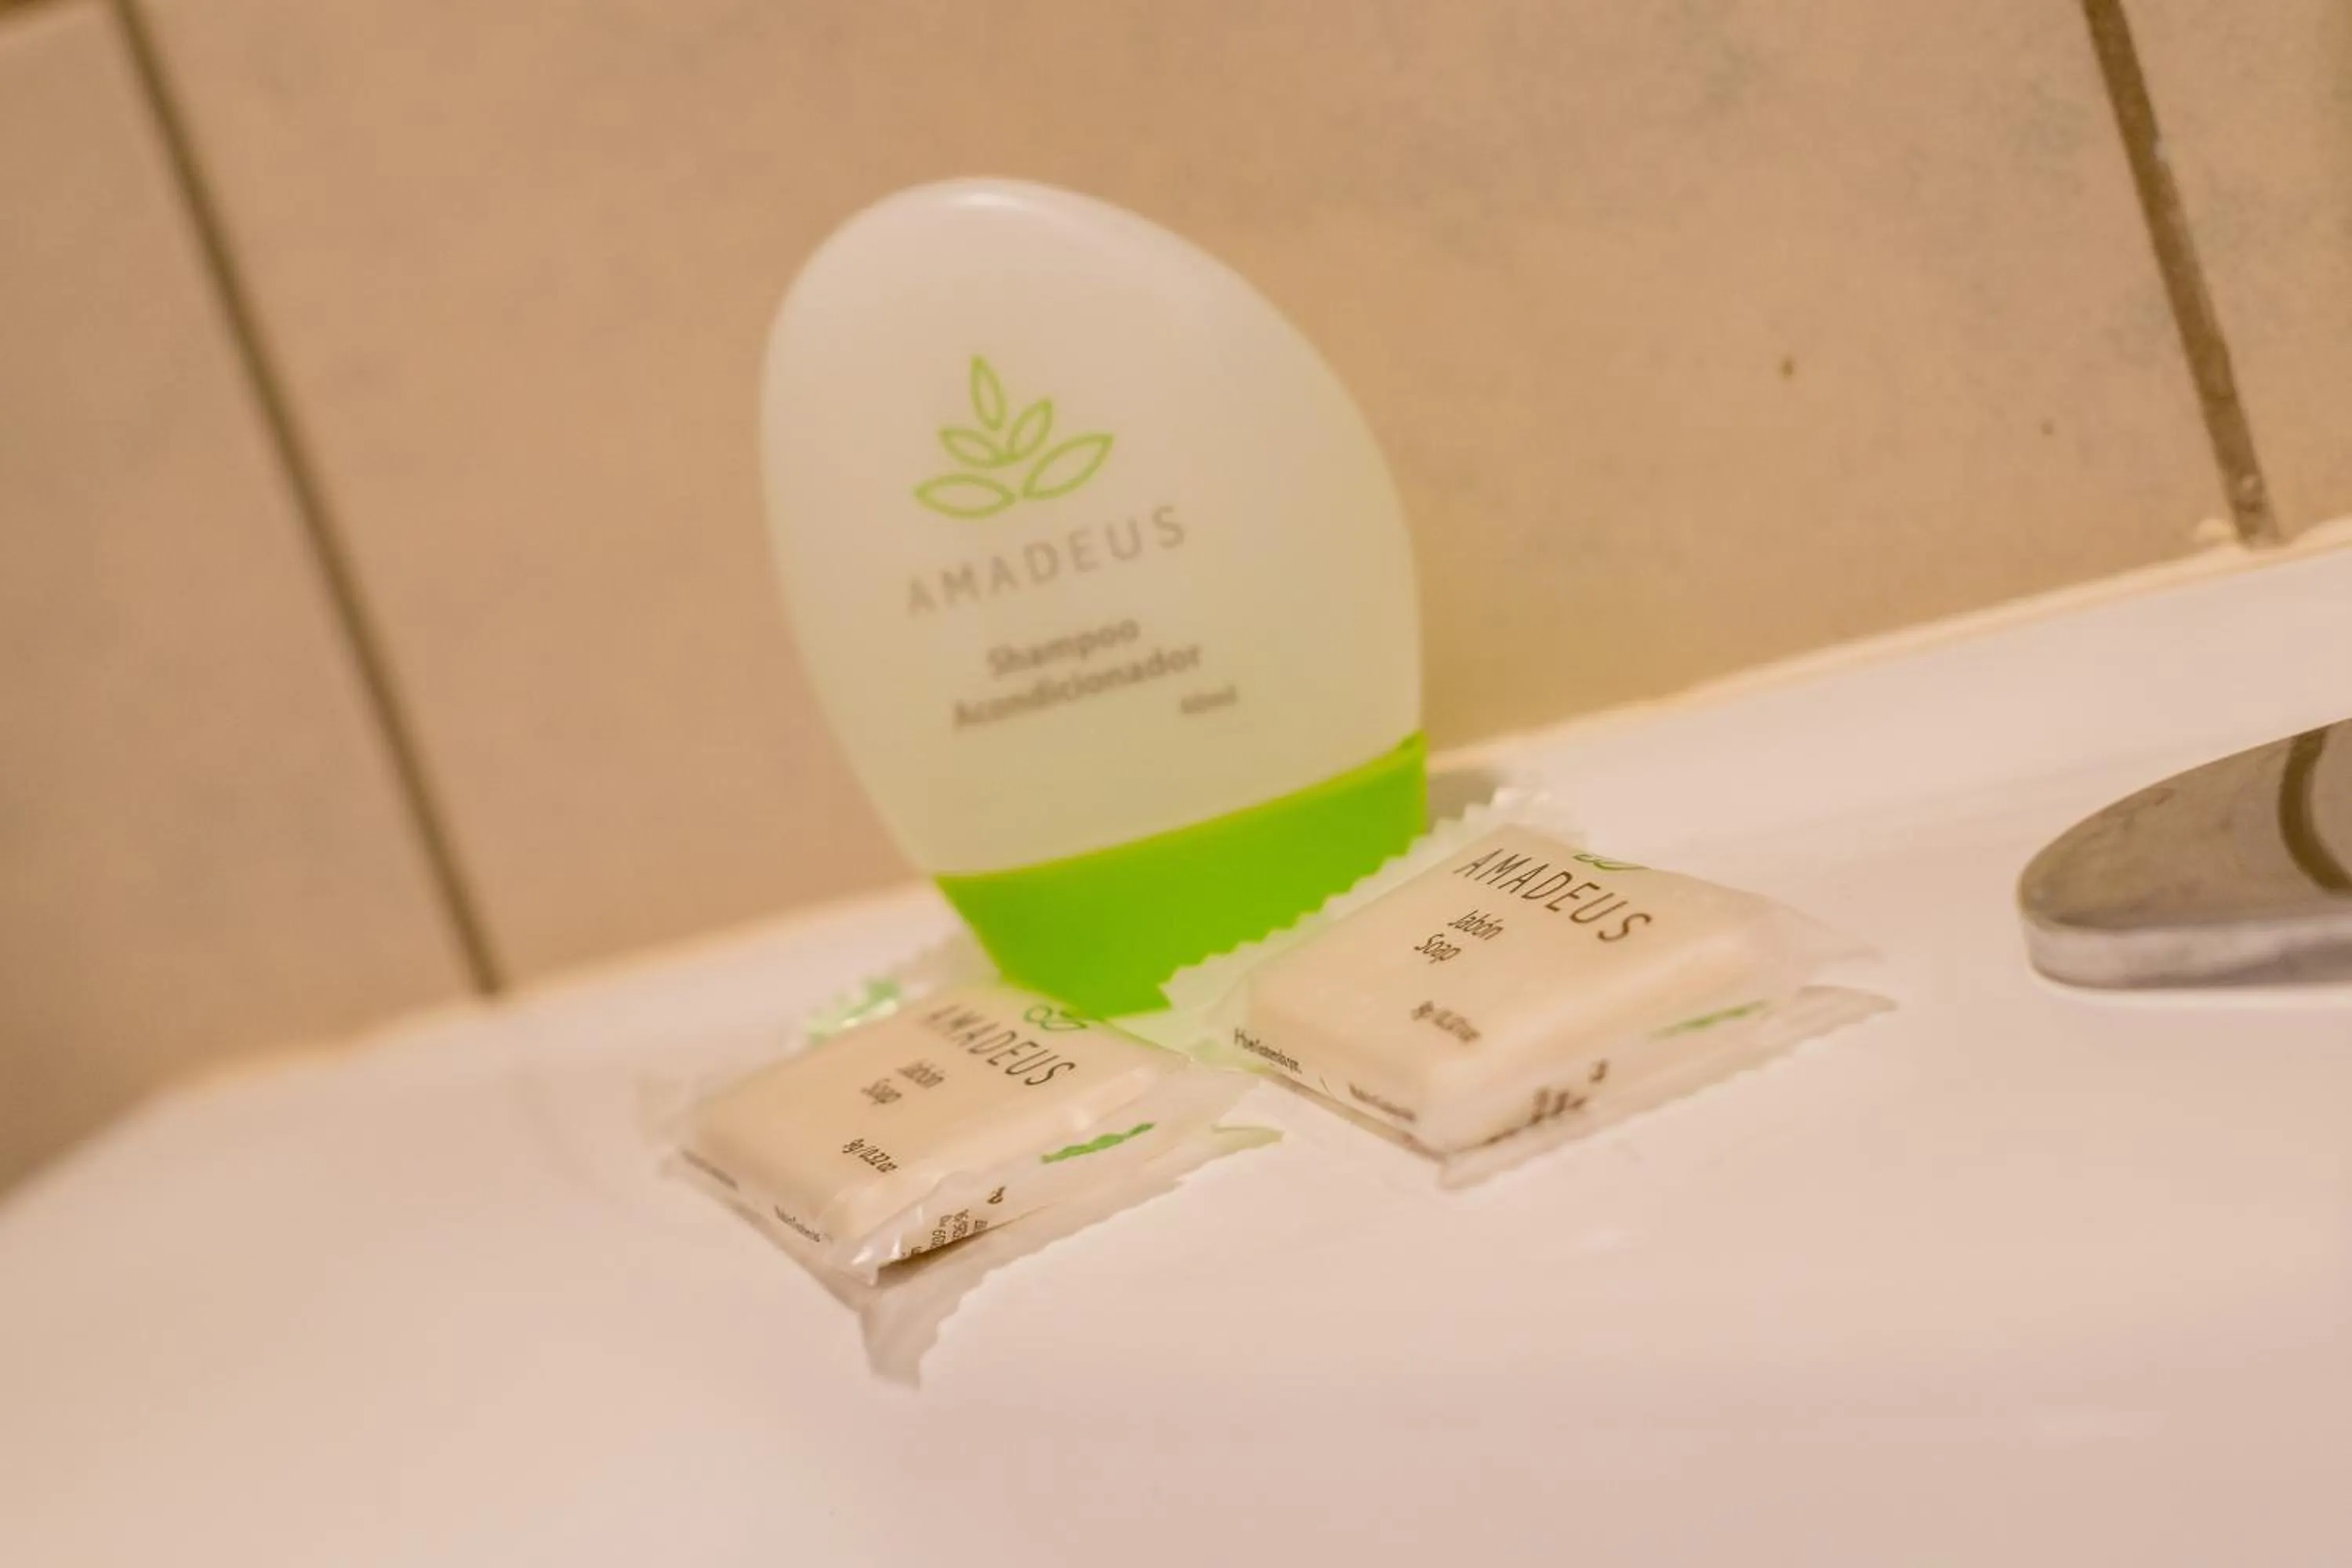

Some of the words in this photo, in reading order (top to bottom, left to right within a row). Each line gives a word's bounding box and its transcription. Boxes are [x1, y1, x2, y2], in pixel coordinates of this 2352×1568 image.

[906, 505, 1186, 618] AMADEUS
[986, 619, 1141, 680] Shampoo
[1446, 909, 1504, 942] Jabón
[1452, 848, 1653, 943] AMADEUS
[1413, 932, 1462, 964] Soap
[922, 1004, 1076, 1086] AMADEUS
